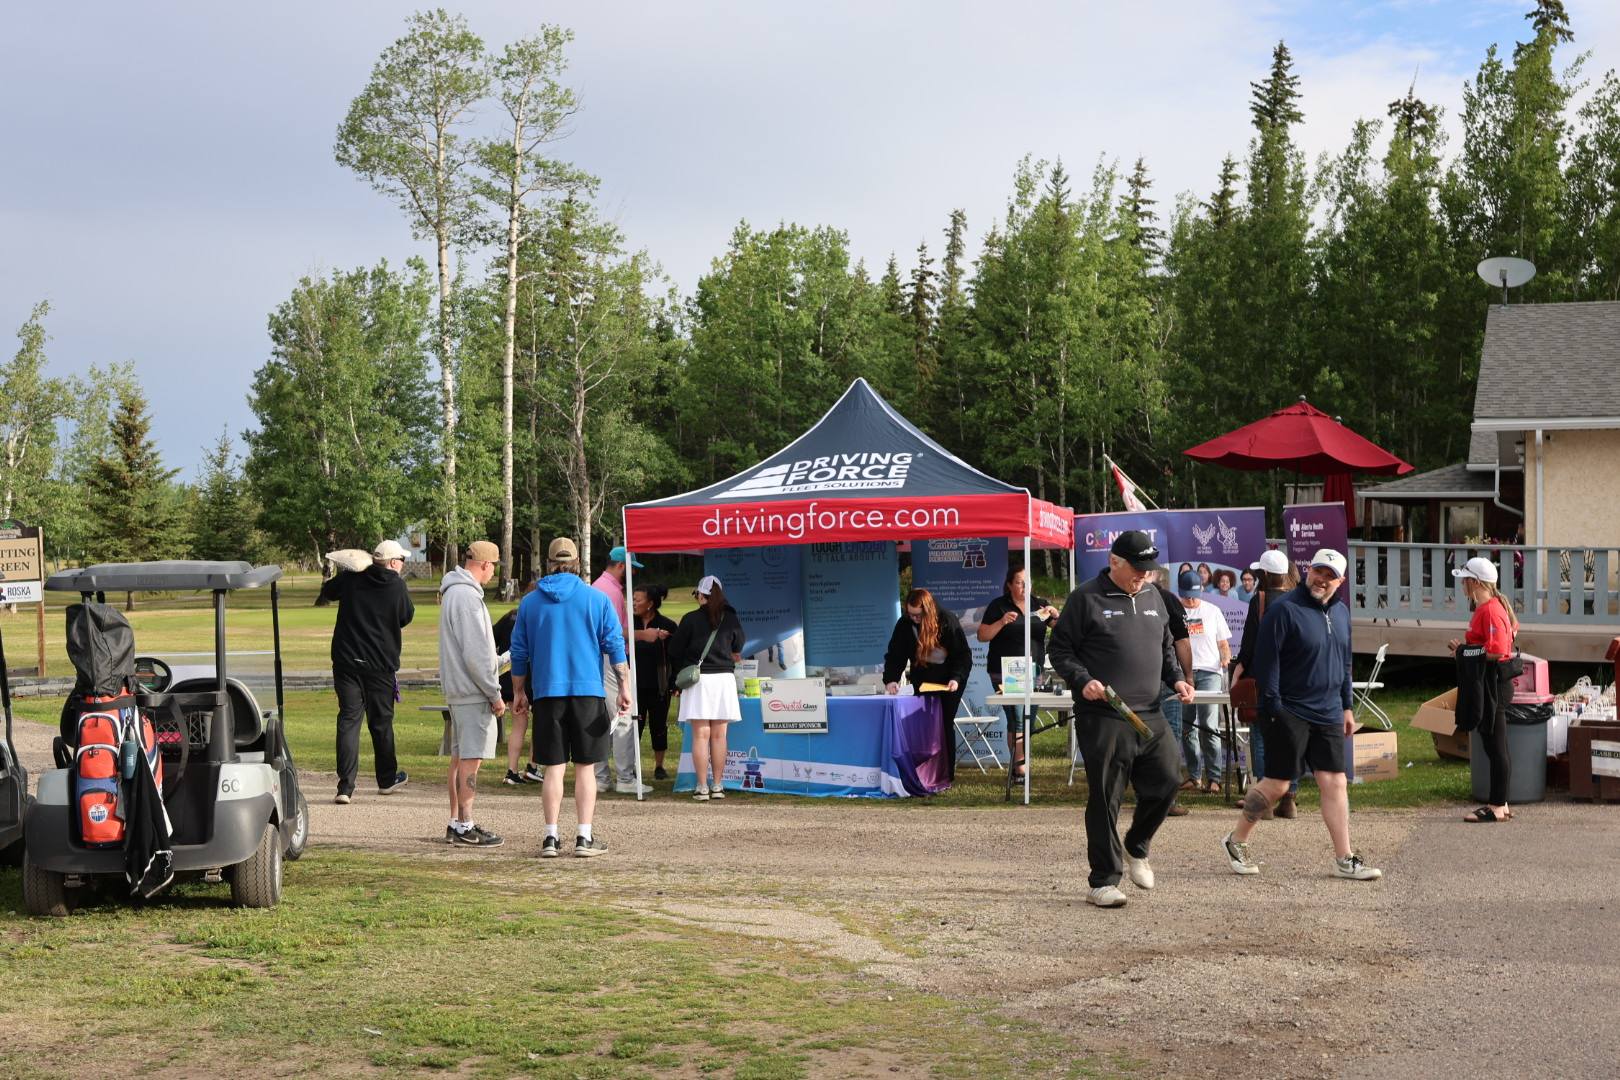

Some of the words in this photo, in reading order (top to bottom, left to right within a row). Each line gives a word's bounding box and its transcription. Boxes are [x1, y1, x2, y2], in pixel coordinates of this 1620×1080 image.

[792, 452, 912, 472] DRIVING
[786, 465, 910, 485] FORCE
[782, 483, 820, 492] FLEET
[823, 480, 900, 489] SOLUTIONS
[702, 502, 960, 539] drivingforce.com
[7, 587, 31, 597] ROSKA
